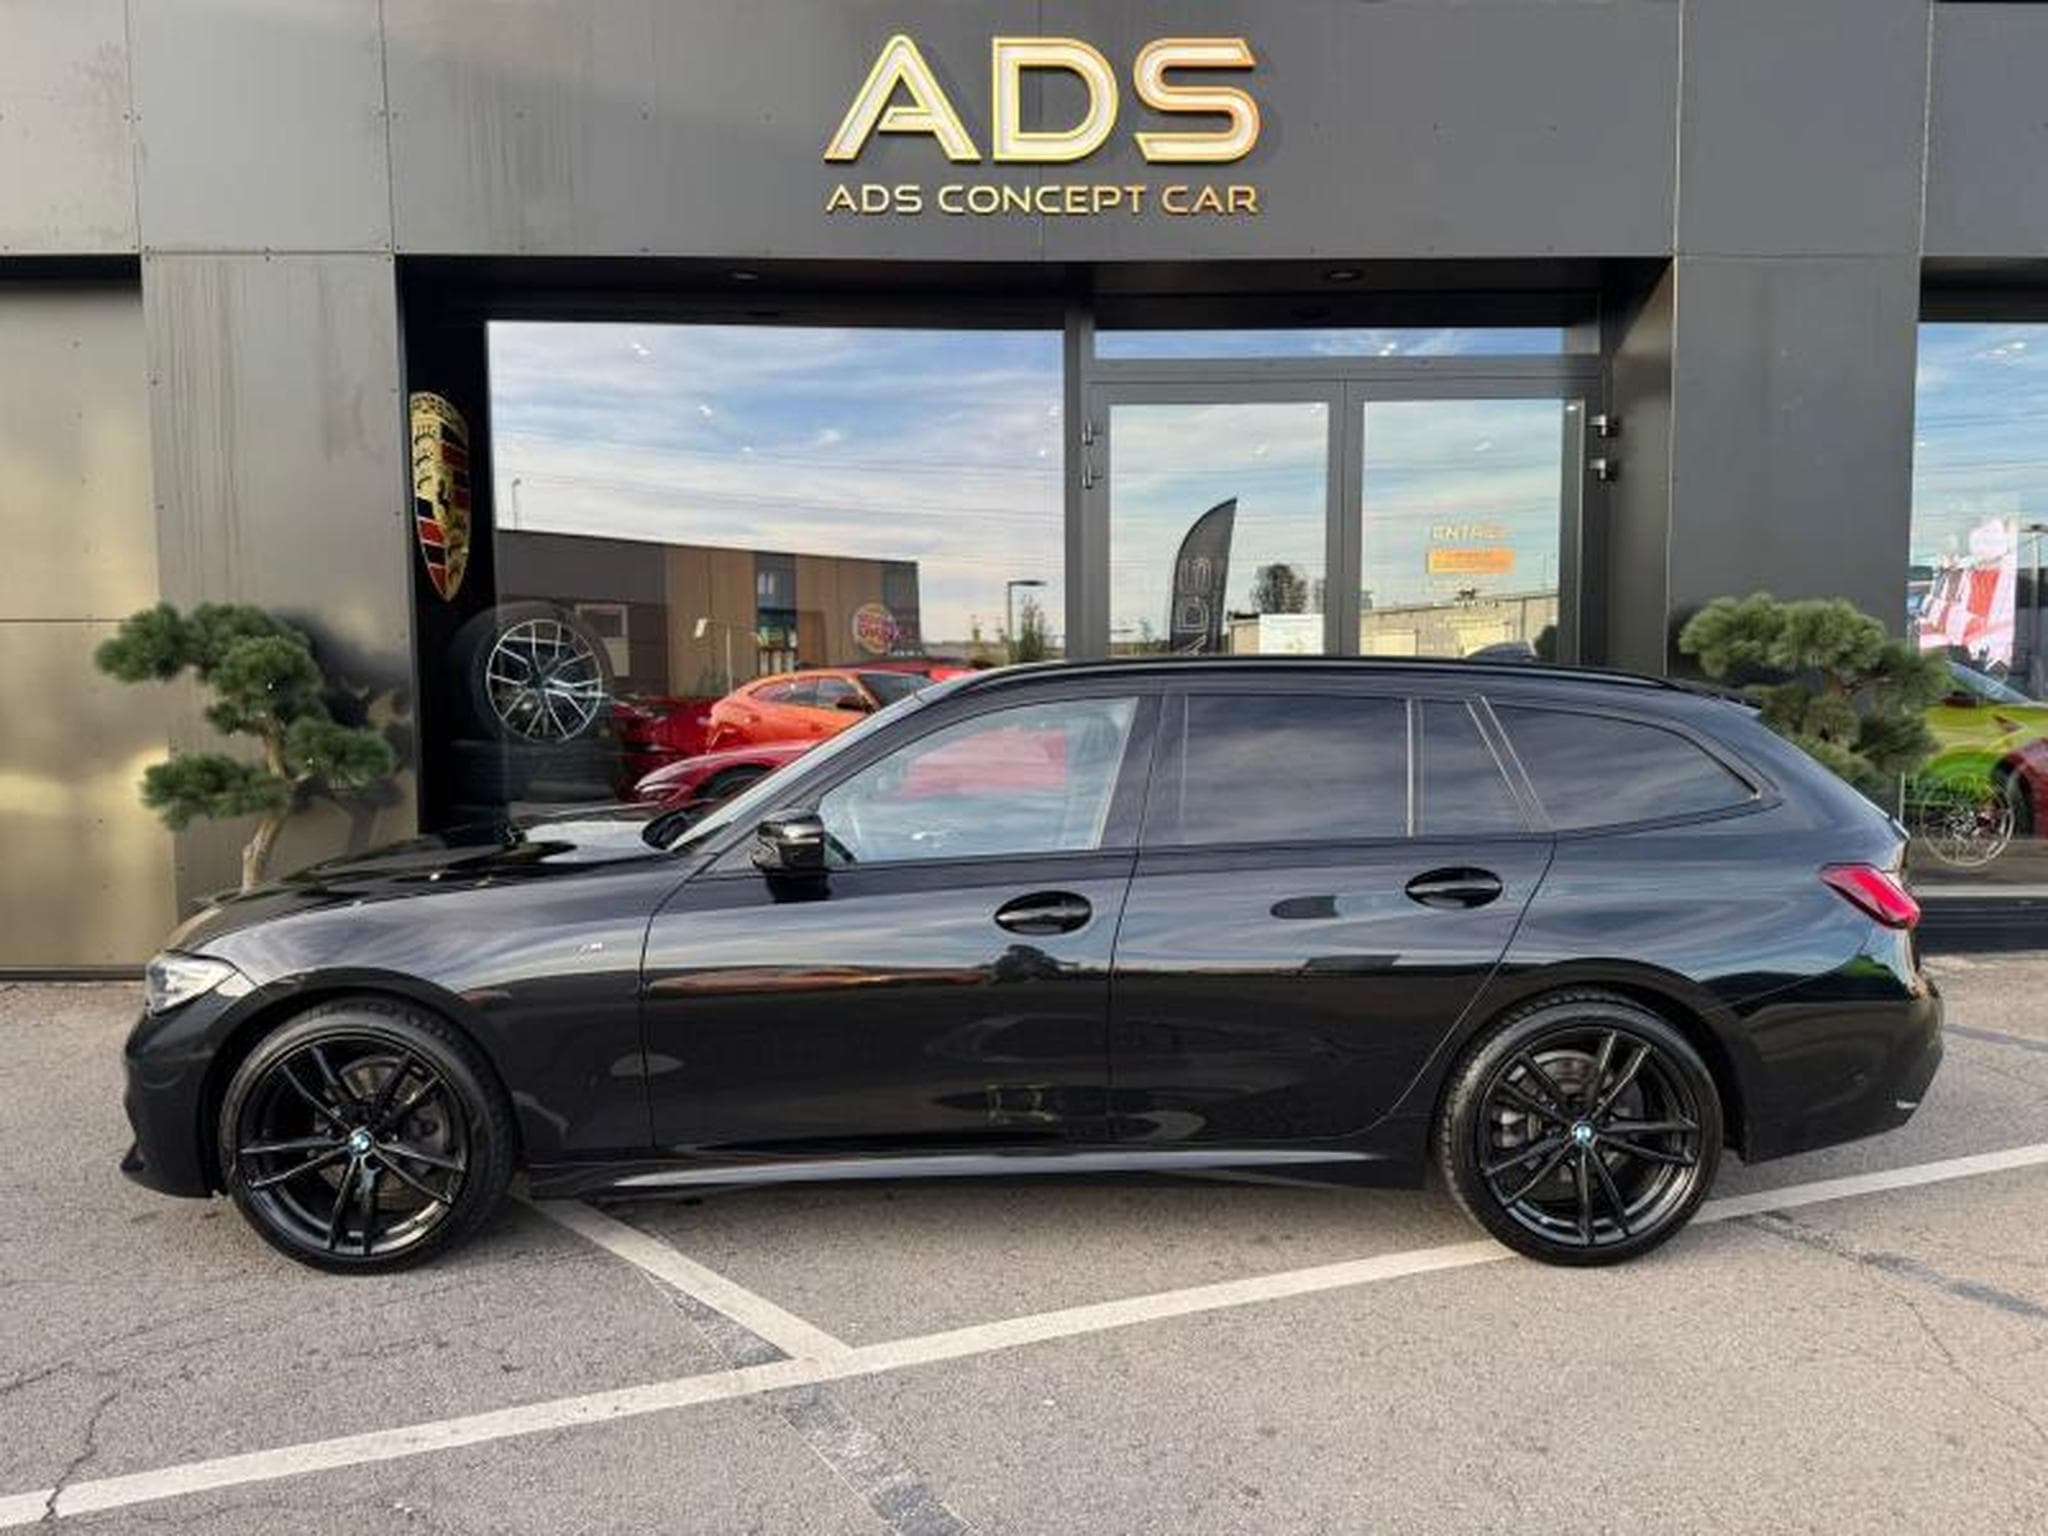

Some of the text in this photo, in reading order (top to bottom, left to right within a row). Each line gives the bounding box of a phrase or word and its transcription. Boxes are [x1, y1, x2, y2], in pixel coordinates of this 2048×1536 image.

[824, 34, 1261, 162] ADS
[826, 184, 1260, 214] ADS CONCEPT CAR
